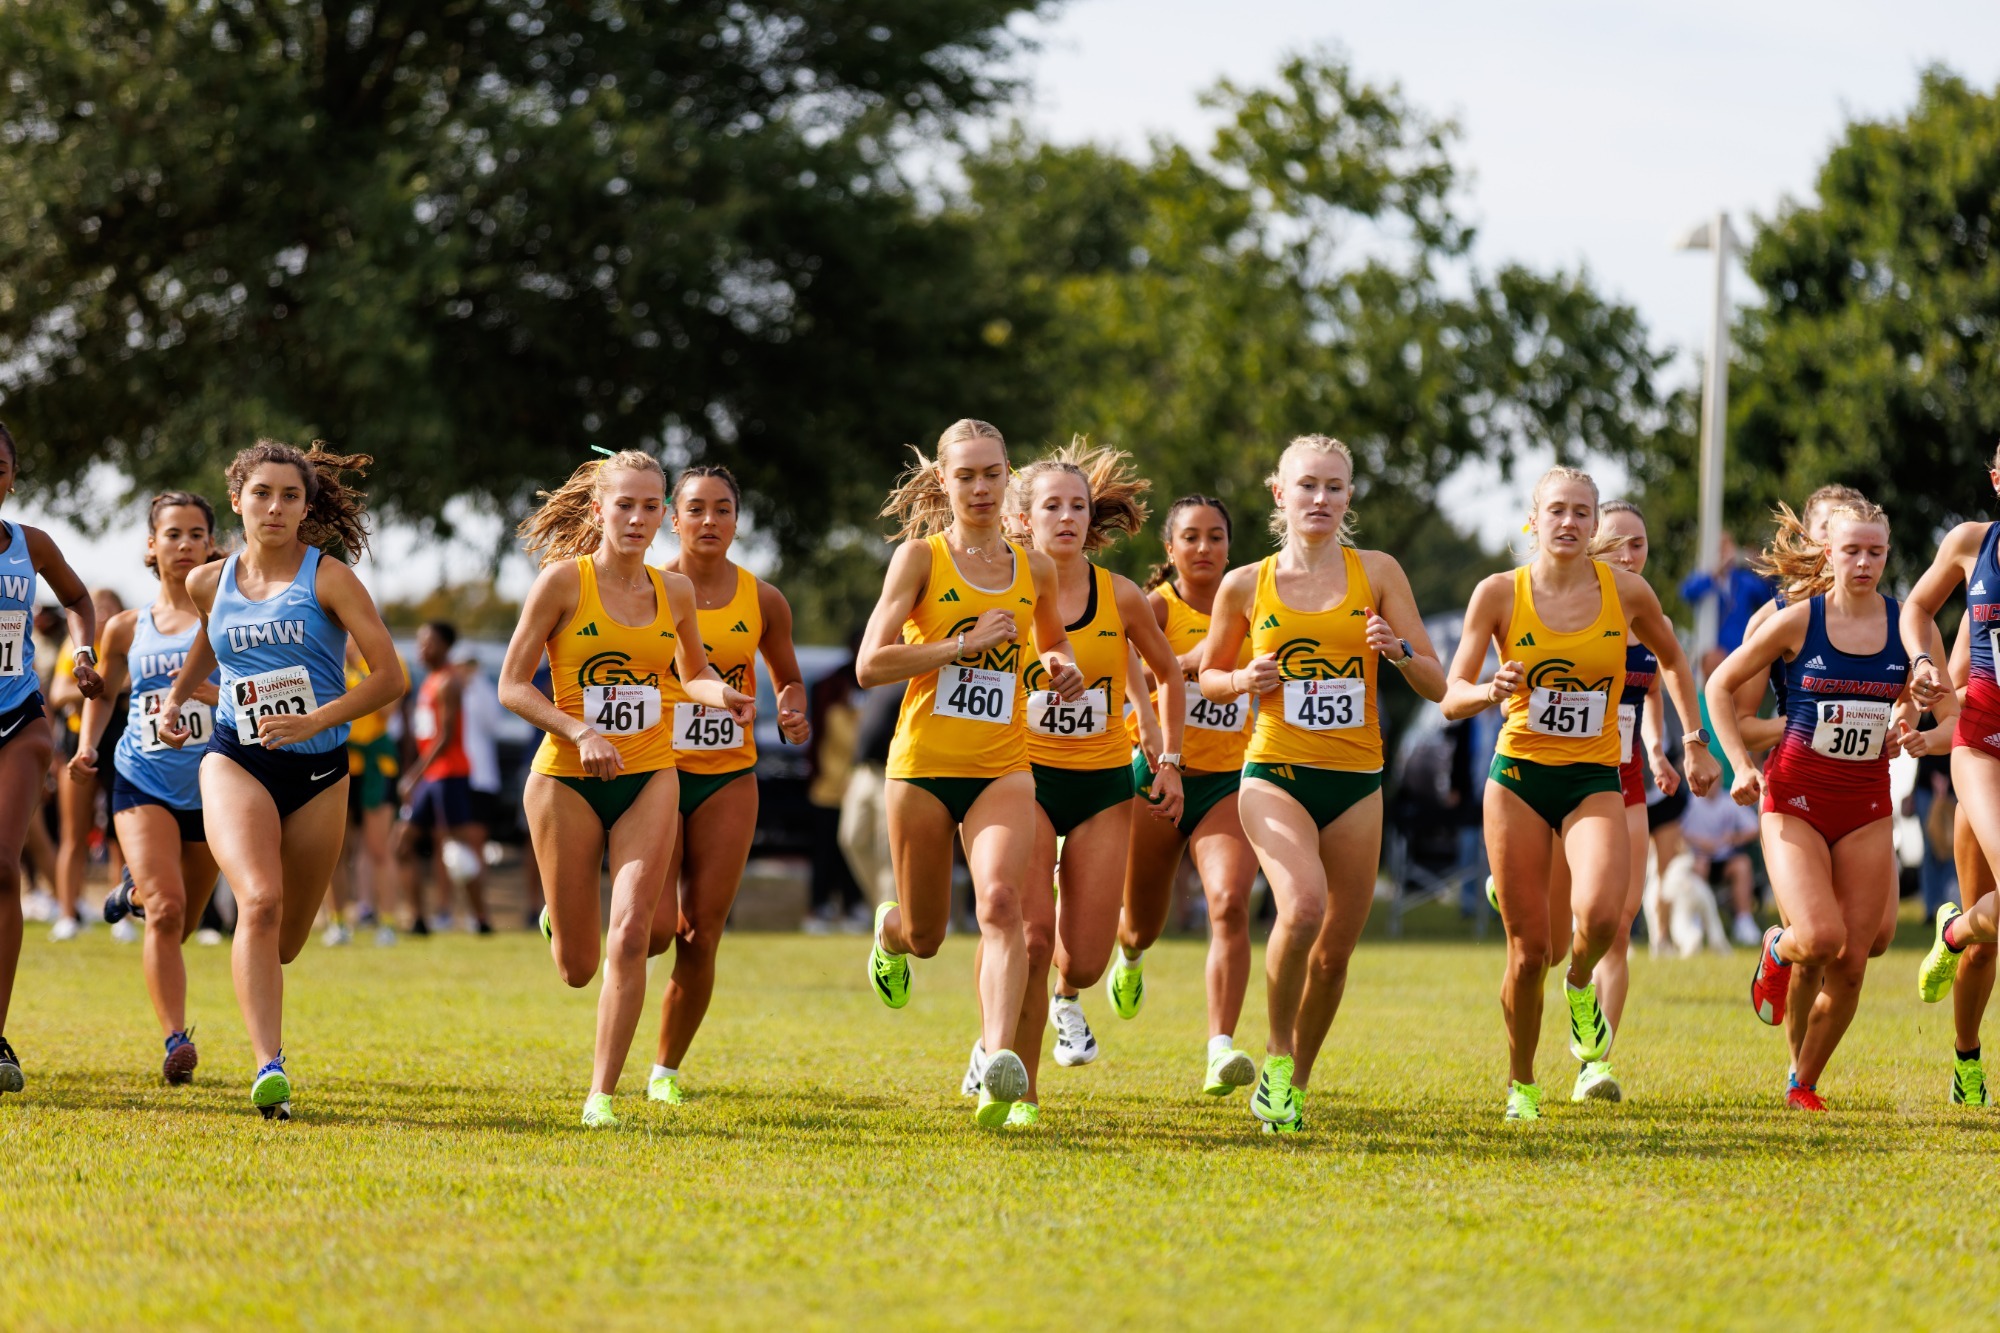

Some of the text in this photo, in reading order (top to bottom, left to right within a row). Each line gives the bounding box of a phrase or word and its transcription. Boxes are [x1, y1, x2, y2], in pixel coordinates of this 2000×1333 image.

[0, 575, 30, 603] W
[227, 620, 305, 654] UMW
[256, 671, 303, 686] COLLEGIATE
[973, 674, 1001, 683] RUNNING
[1804, 663, 1827, 671] adidas
[257, 677, 305, 694] RUNNING
[260, 687, 308, 702] ASSOCIATION
[947, 683, 1004, 719] 460
[1190, 698, 1239, 728] 458
[1297, 694, 1353, 726] 453
[595, 701, 645, 731] 461
[1040, 706, 1095, 735] 454
[1538, 705, 1590, 733] 451
[1846, 711, 1885, 720] RUNNING
[685, 717, 734, 746] 459
[1828, 727, 1872, 757] 305
